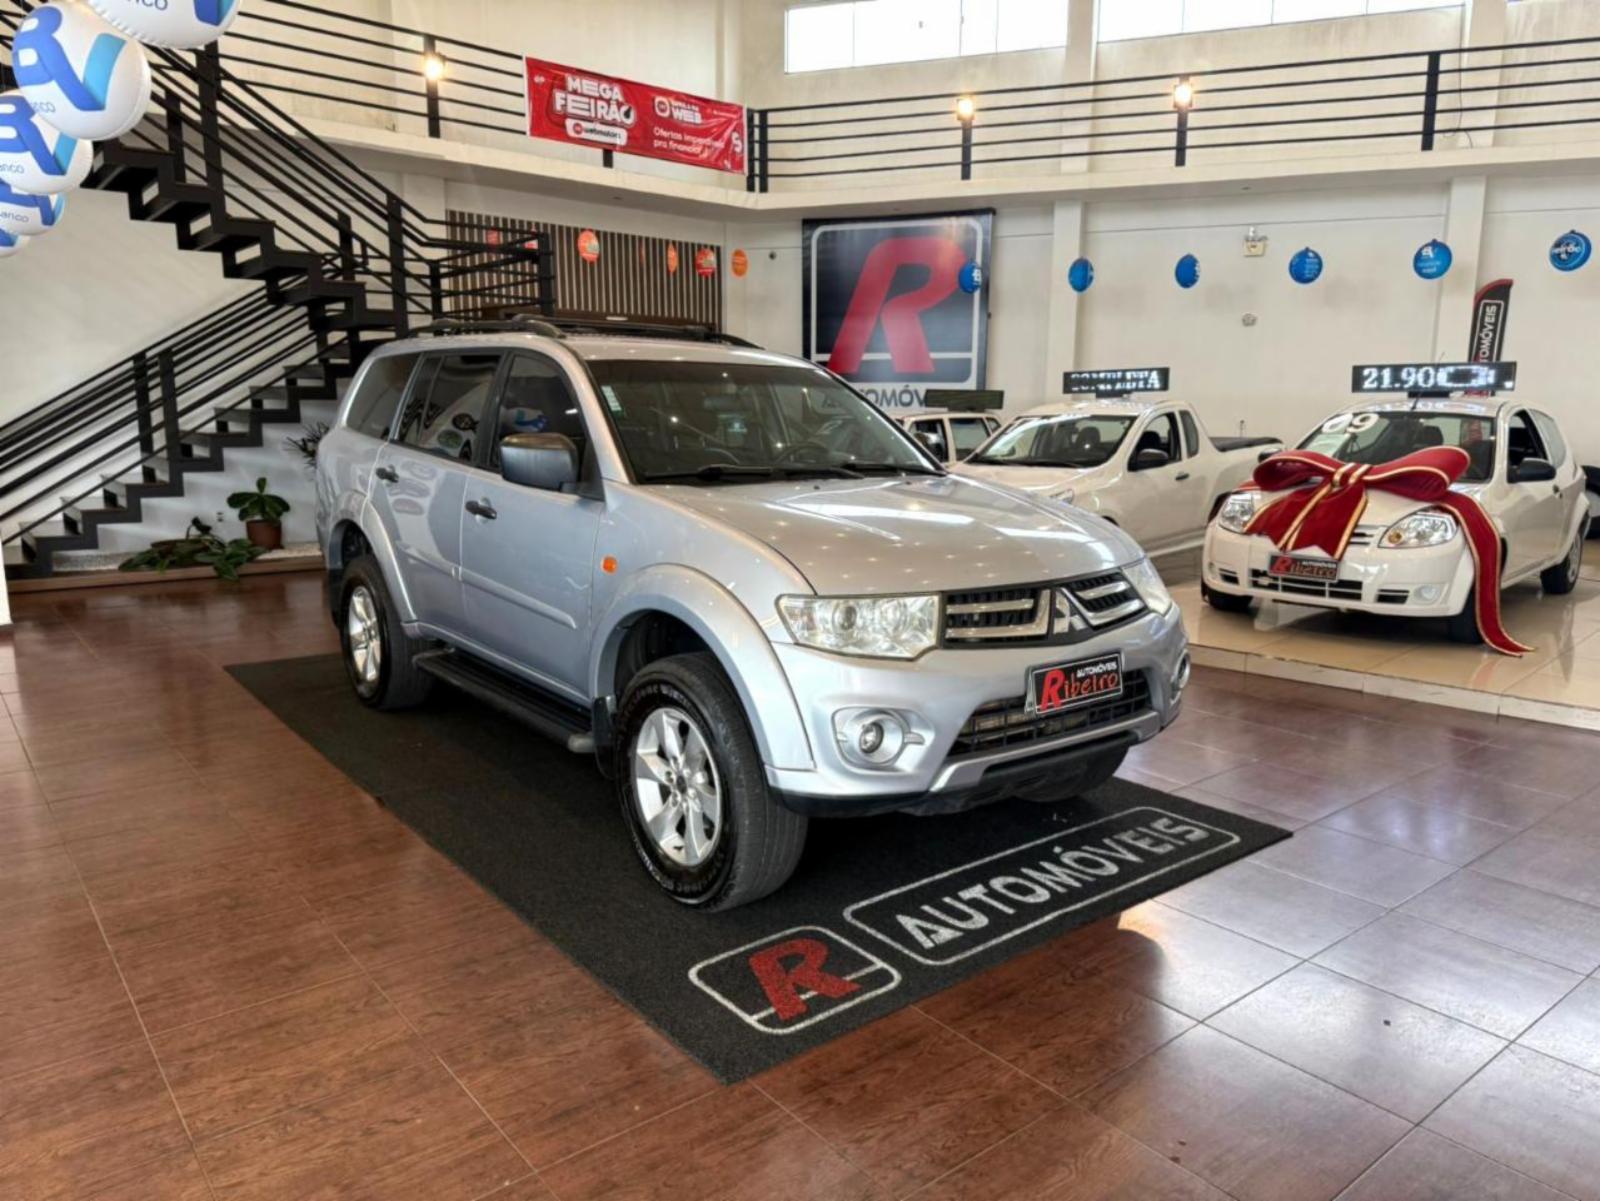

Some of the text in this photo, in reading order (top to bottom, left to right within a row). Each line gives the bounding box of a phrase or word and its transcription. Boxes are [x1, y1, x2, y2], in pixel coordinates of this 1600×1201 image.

[566, 74, 622, 102] MEGA
[826, 235, 966, 374] R
[1040, 667, 1119, 710] Ribeiro
[894, 815, 1211, 949] AUTOMÓVEIS
[746, 936, 863, 1022] R
